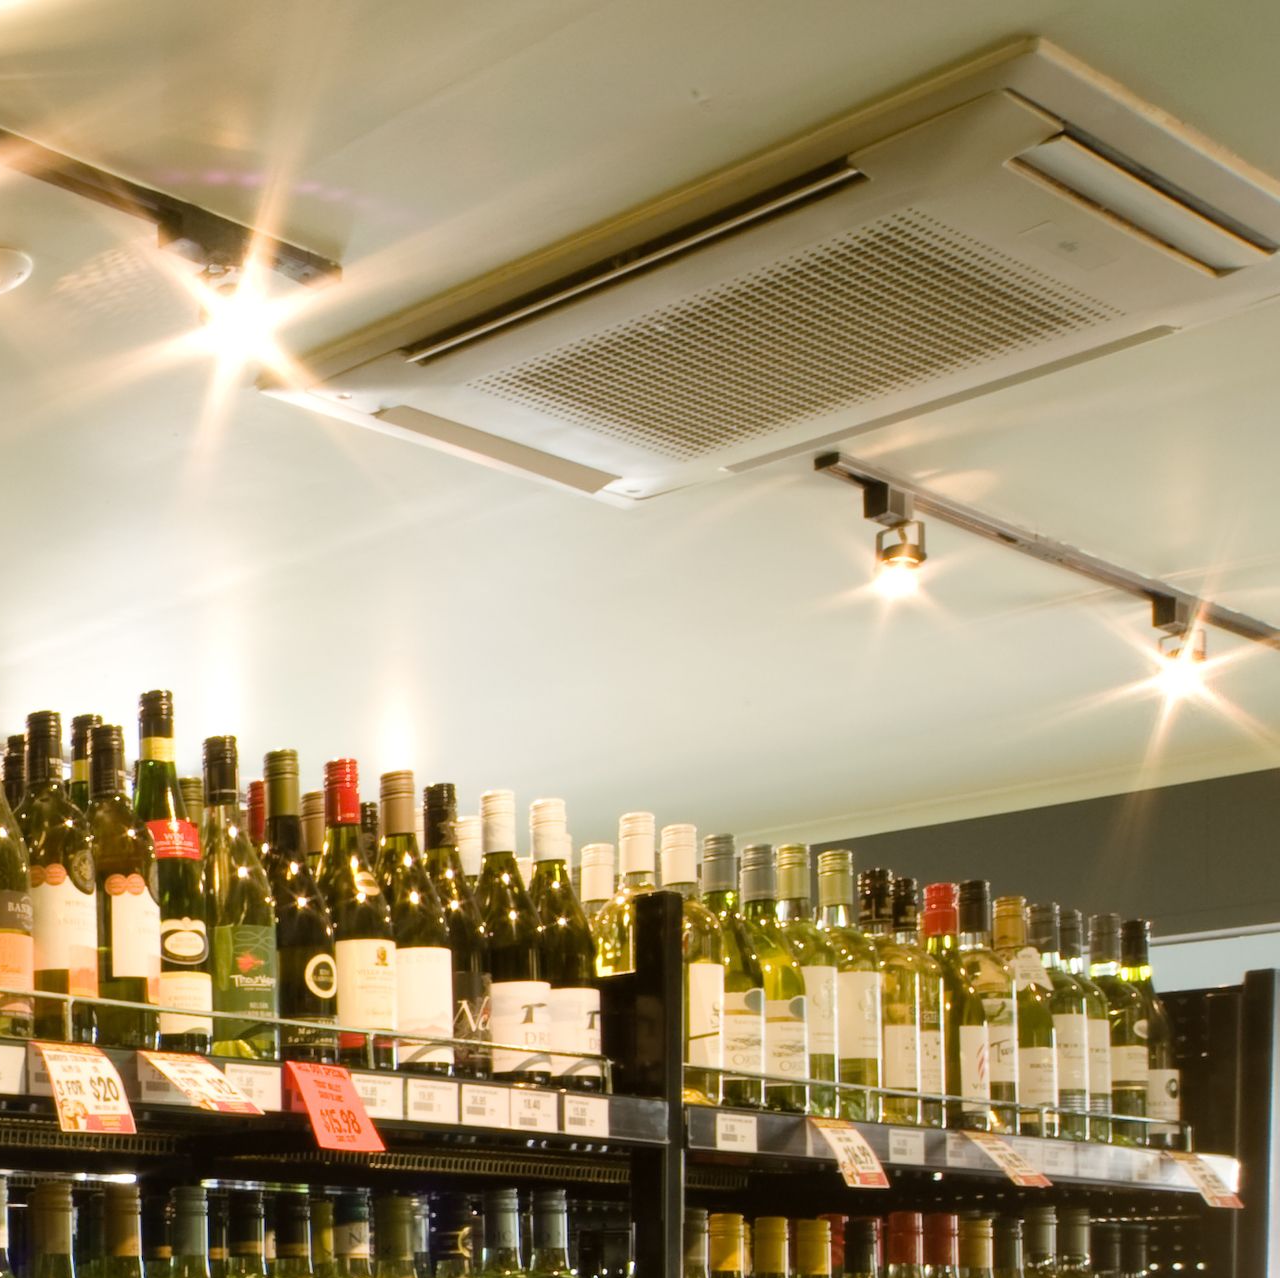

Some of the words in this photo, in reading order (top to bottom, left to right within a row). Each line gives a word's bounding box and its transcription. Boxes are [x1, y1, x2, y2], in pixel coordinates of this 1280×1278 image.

[58, 1080, 67, 1095] 3
[65, 1079, 86, 1096] FOR
[89, 1077, 119, 1103] $20
[318, 1109, 361, 1135] $15.98
